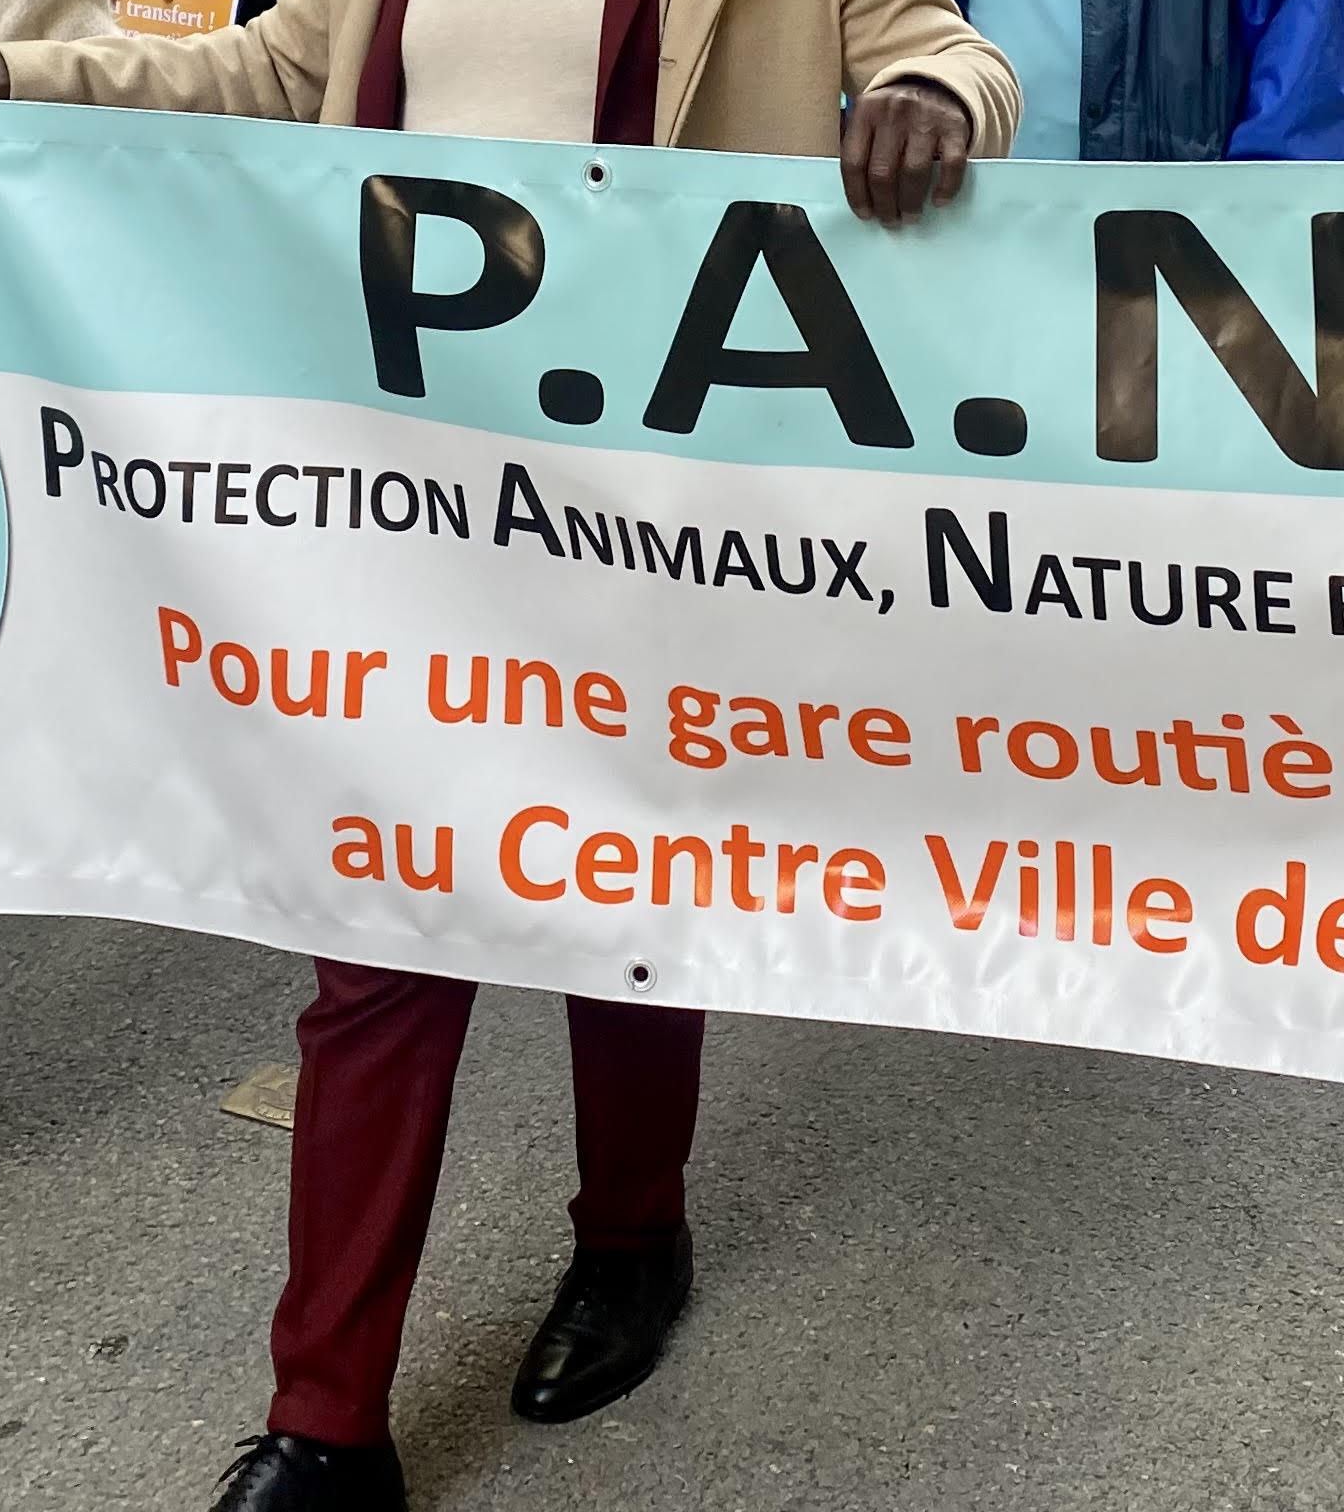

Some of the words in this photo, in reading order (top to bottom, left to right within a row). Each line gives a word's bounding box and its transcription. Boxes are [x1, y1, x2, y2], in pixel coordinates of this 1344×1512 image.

[126, 0, 204, 29] transfert
[156, 605, 388, 720] Pour
[427, 651, 629, 738] une
[666, 684, 912, 771] gare
[330, 814, 454, 894] au
[497, 804, 887, 922] Centre
[923, 833, 1193, 955] Ville
